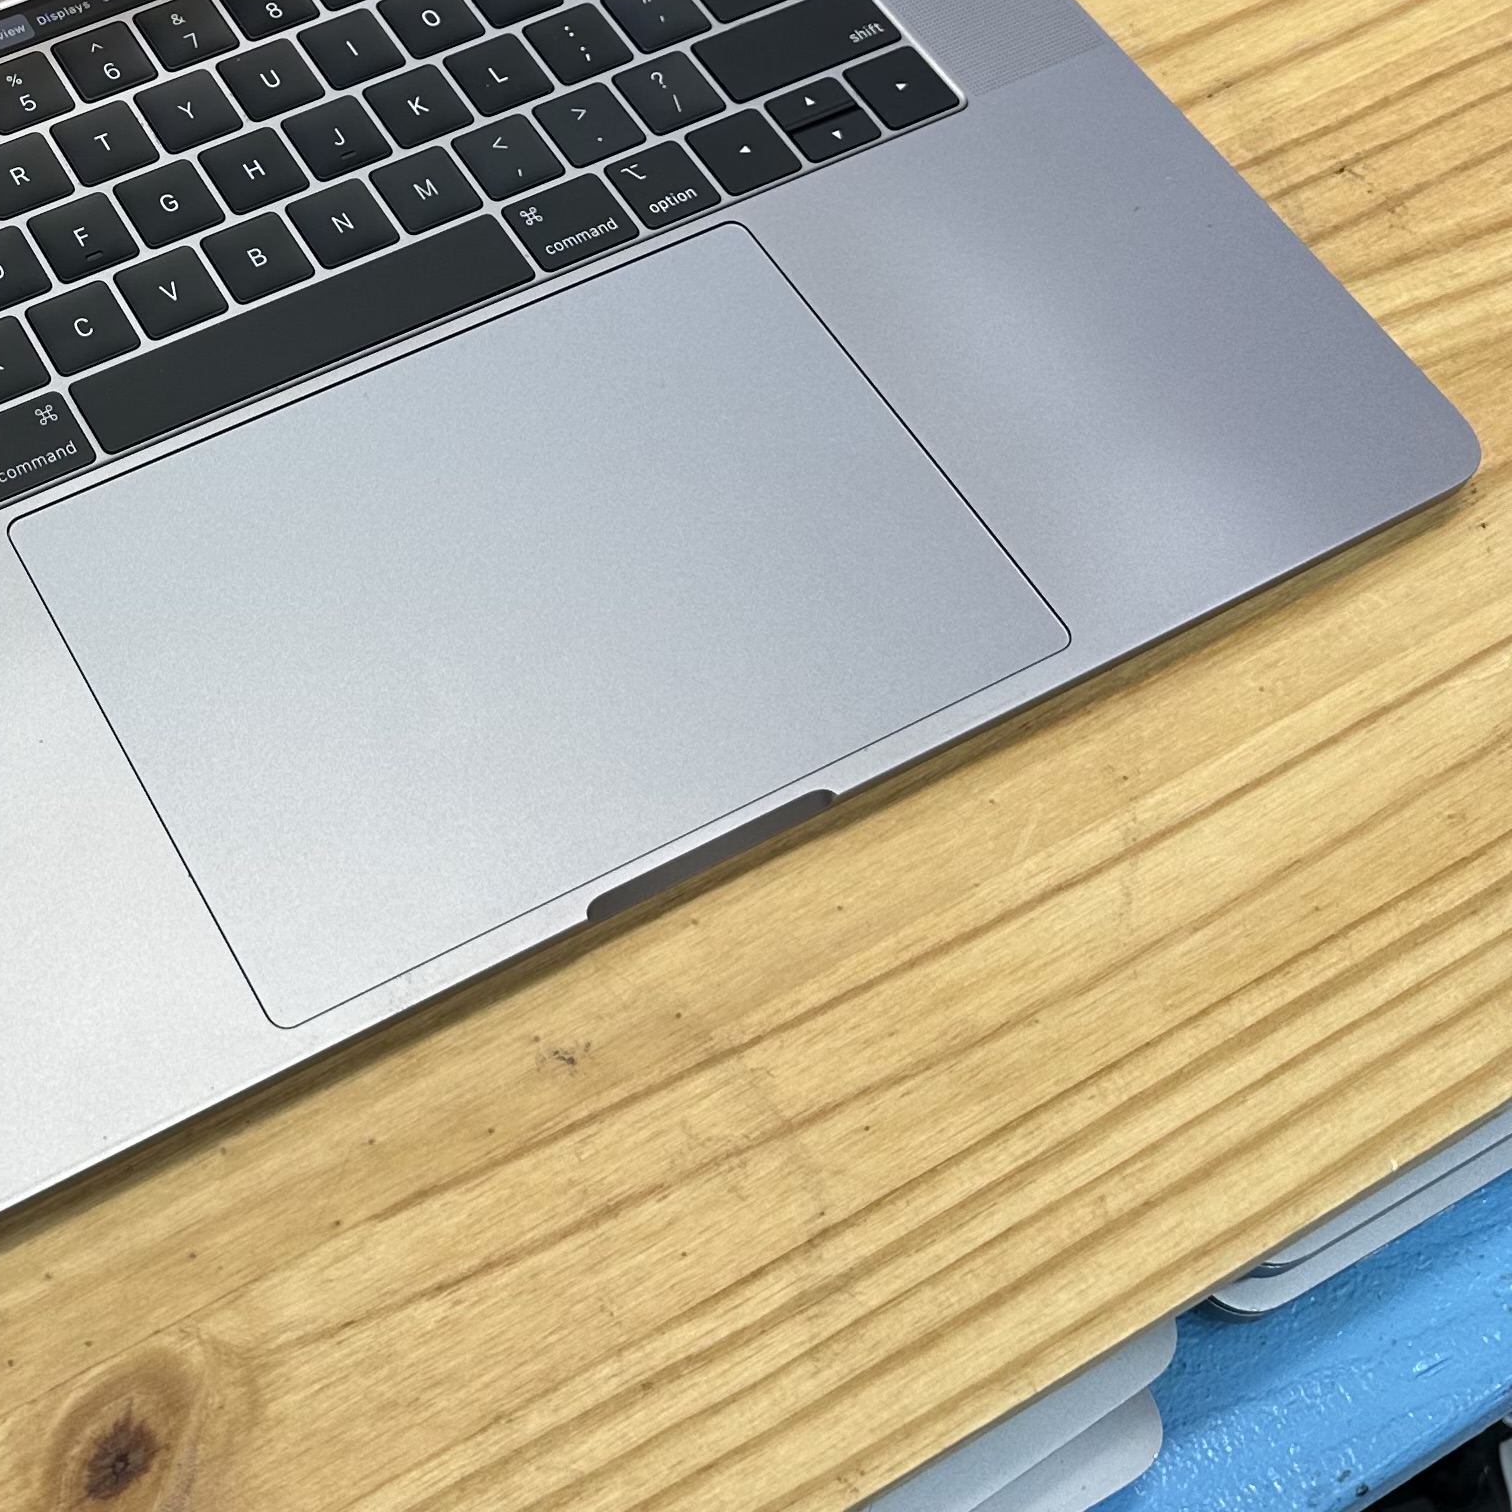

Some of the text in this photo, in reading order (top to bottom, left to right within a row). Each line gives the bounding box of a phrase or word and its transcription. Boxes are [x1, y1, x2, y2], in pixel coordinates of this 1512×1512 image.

[36, 1, 91, 26] Displays
[849, 23, 884, 43] shift
[649, 188, 697, 213] option
[545, 217, 619, 255] command
